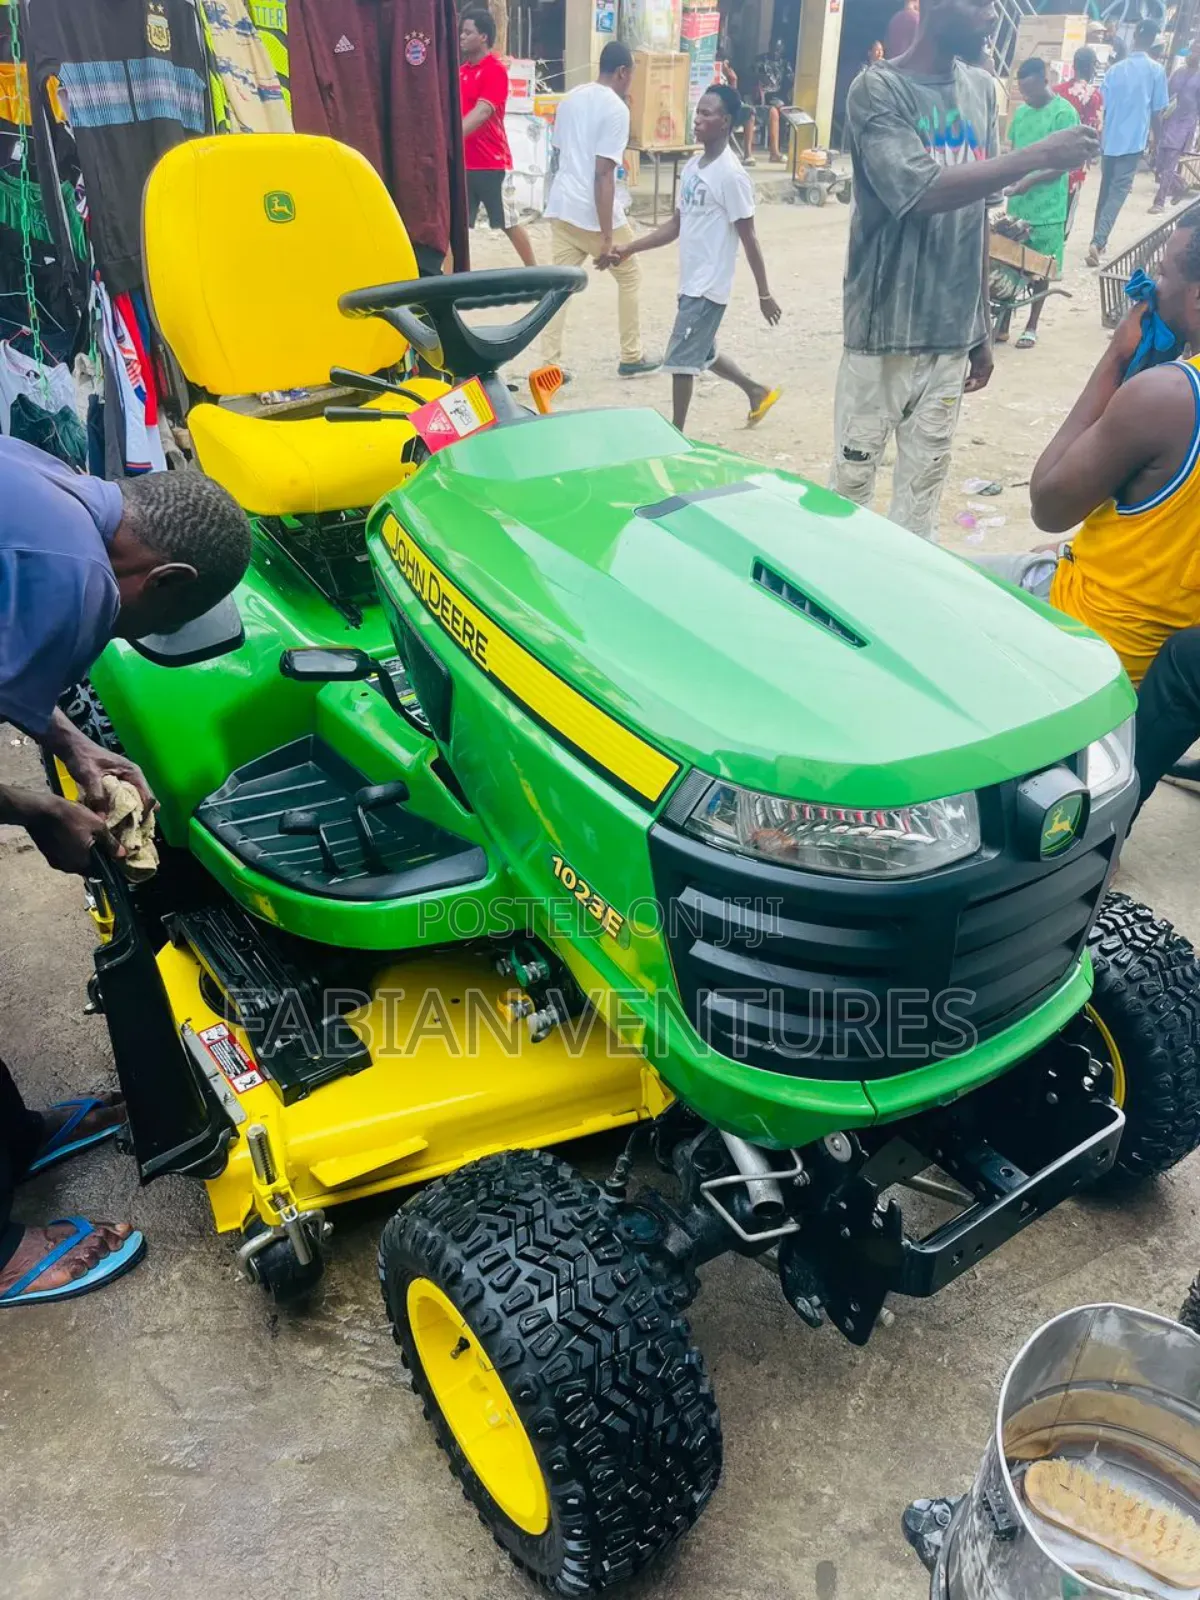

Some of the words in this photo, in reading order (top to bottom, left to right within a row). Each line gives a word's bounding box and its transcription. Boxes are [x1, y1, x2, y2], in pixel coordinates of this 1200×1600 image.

[391, 527, 427, 593] JOHN
[428, 571, 489, 666] DEERE
[551, 854, 625, 939] 1023E
